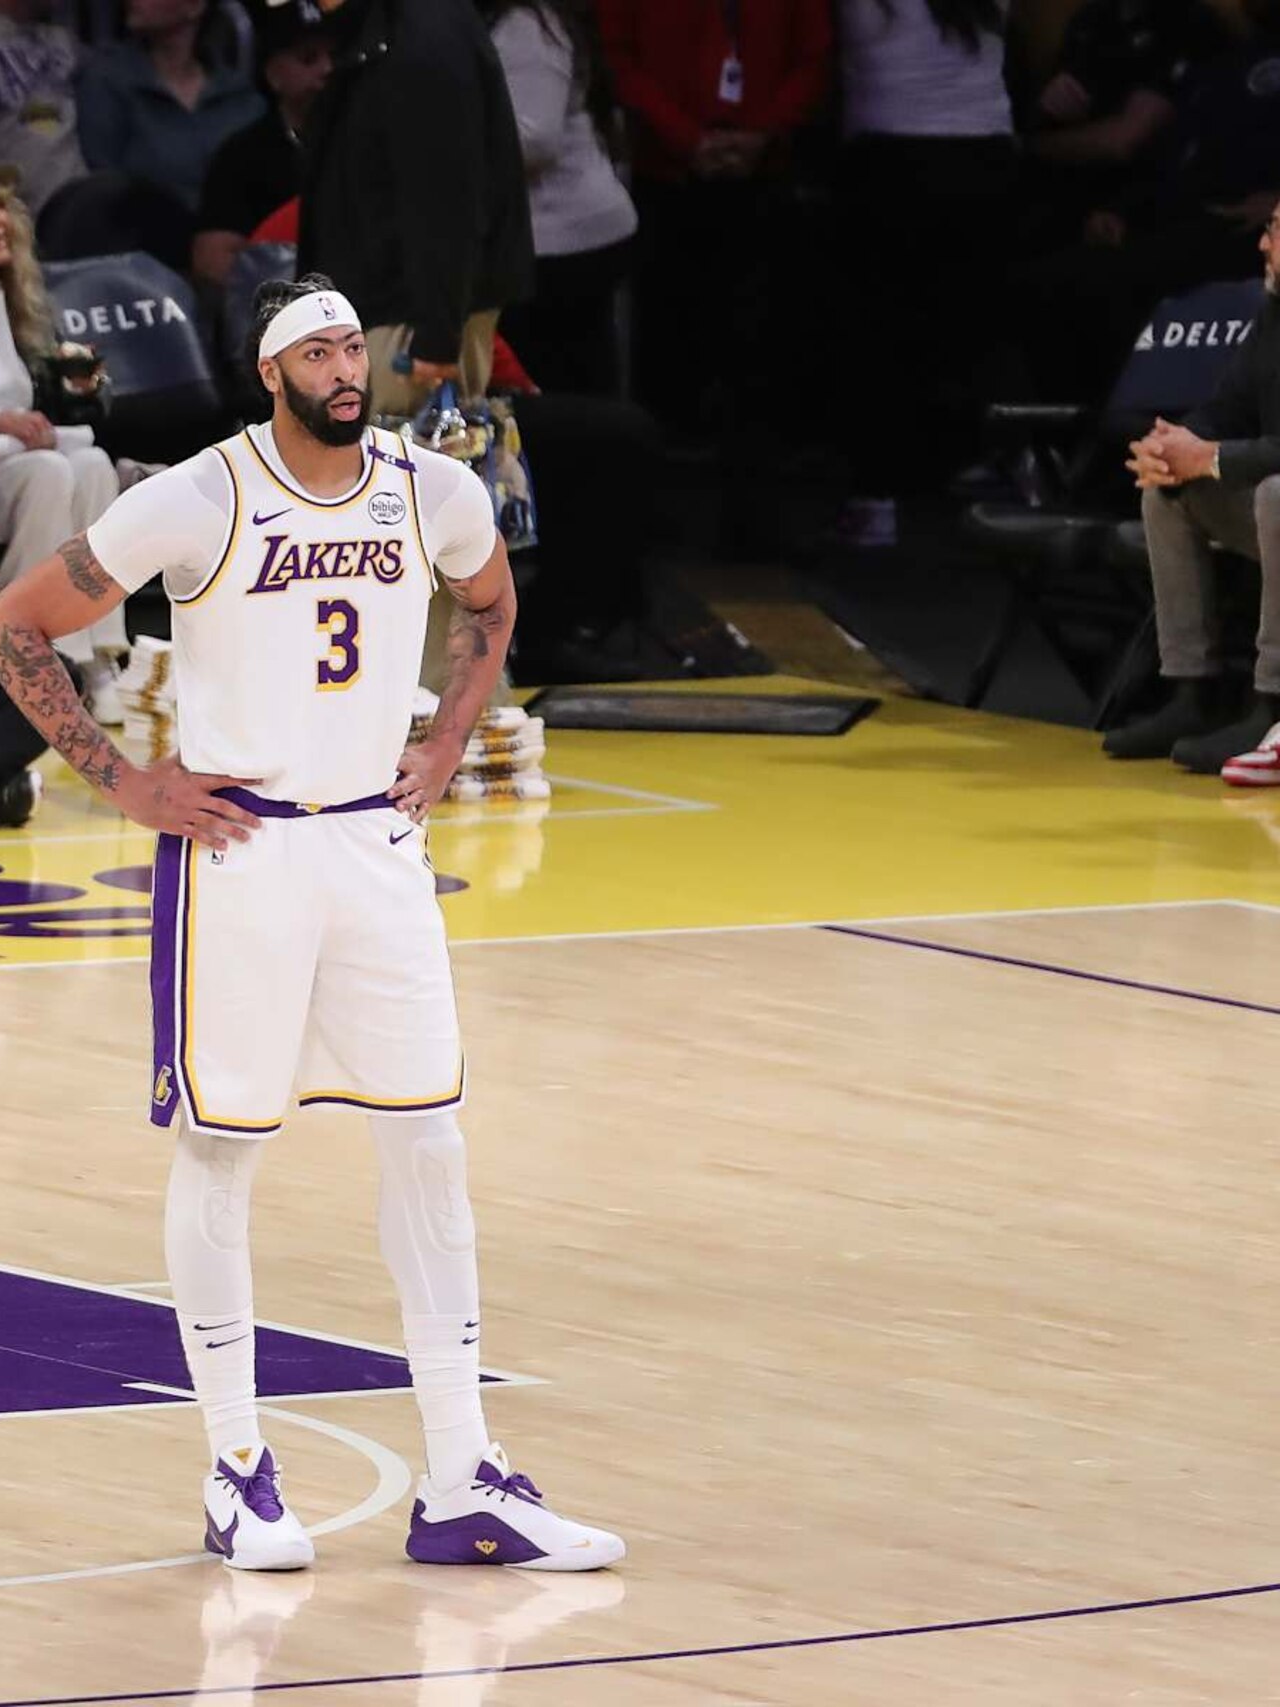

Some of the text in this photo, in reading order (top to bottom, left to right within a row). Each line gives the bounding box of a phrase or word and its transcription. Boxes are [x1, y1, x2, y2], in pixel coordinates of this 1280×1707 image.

[63, 296, 187, 336] DELTA
[371, 499, 404, 516] bibigo
[245, 533, 405, 596] LAKERS
[315, 598, 363, 692] 3
